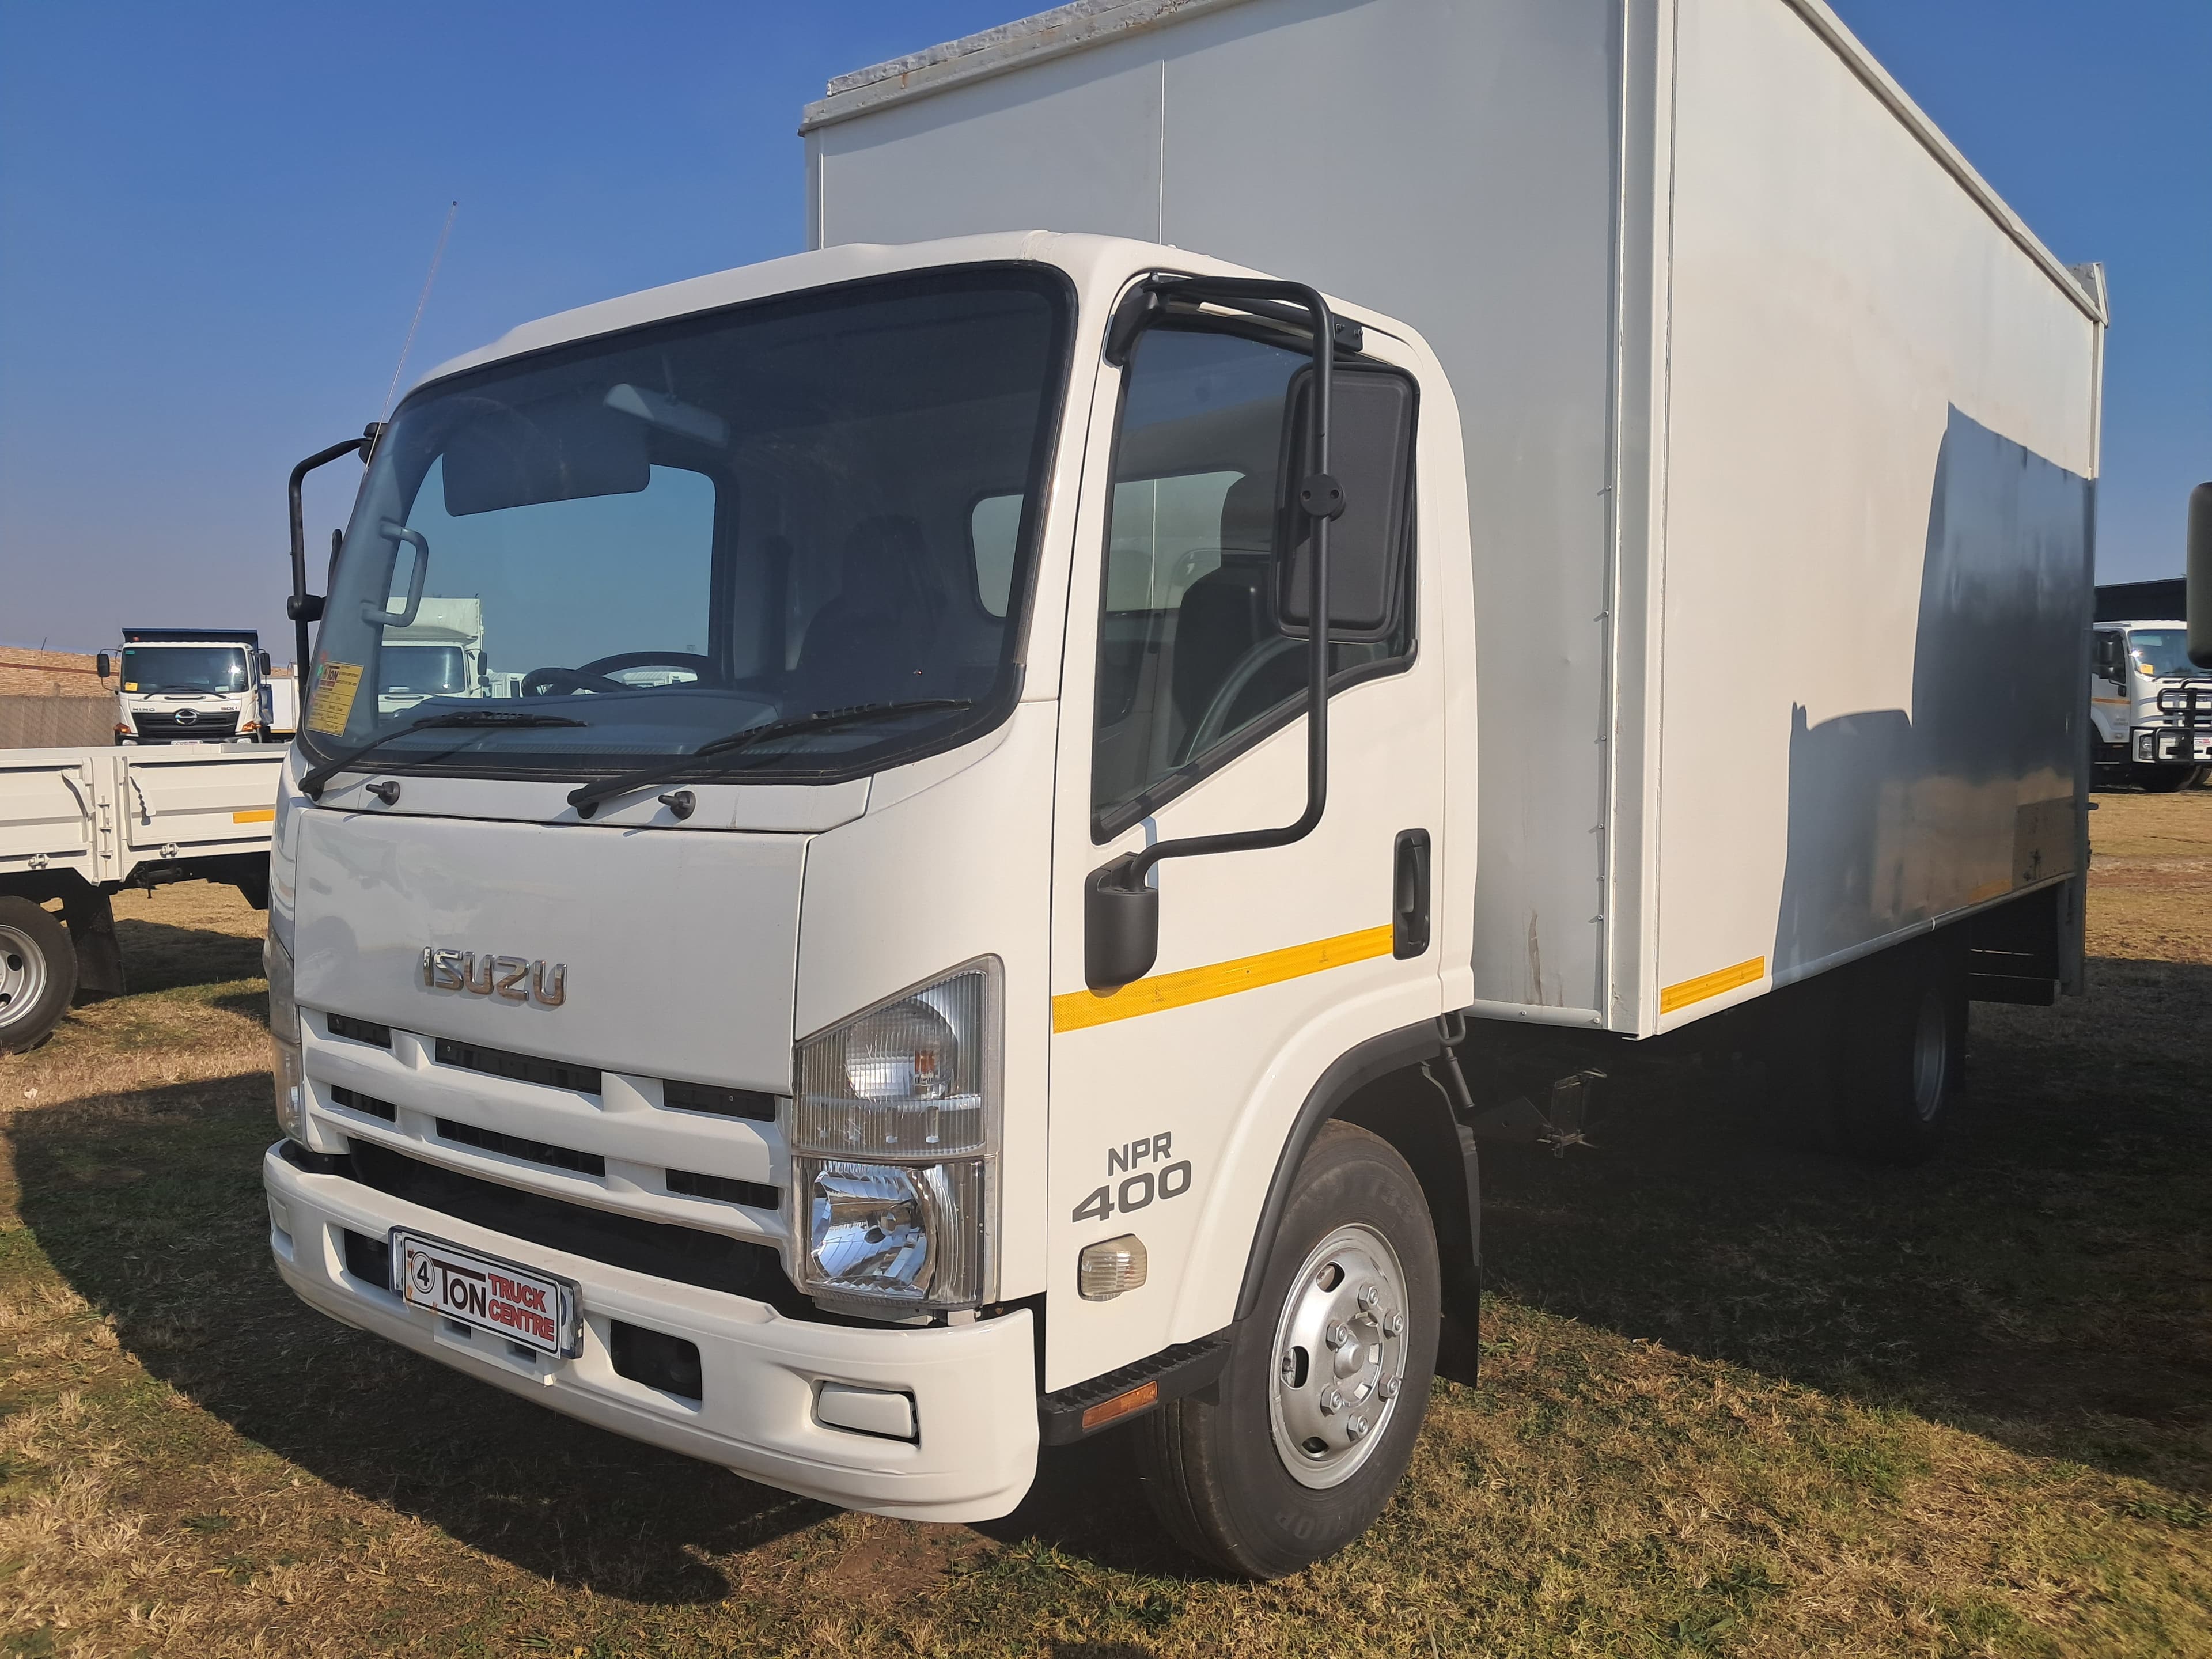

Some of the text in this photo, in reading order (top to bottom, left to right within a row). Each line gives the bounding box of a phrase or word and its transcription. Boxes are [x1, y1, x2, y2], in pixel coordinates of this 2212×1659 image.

[423, 946, 567, 1006] ISUZU
[1108, 1131, 1171, 1176] NPR
[1072, 1160, 1191, 1222] 400
[416, 1257, 486, 1318] 4 TON
[488, 1272, 546, 1313] TRUCK
[488, 1298, 554, 1342] CENTRE
